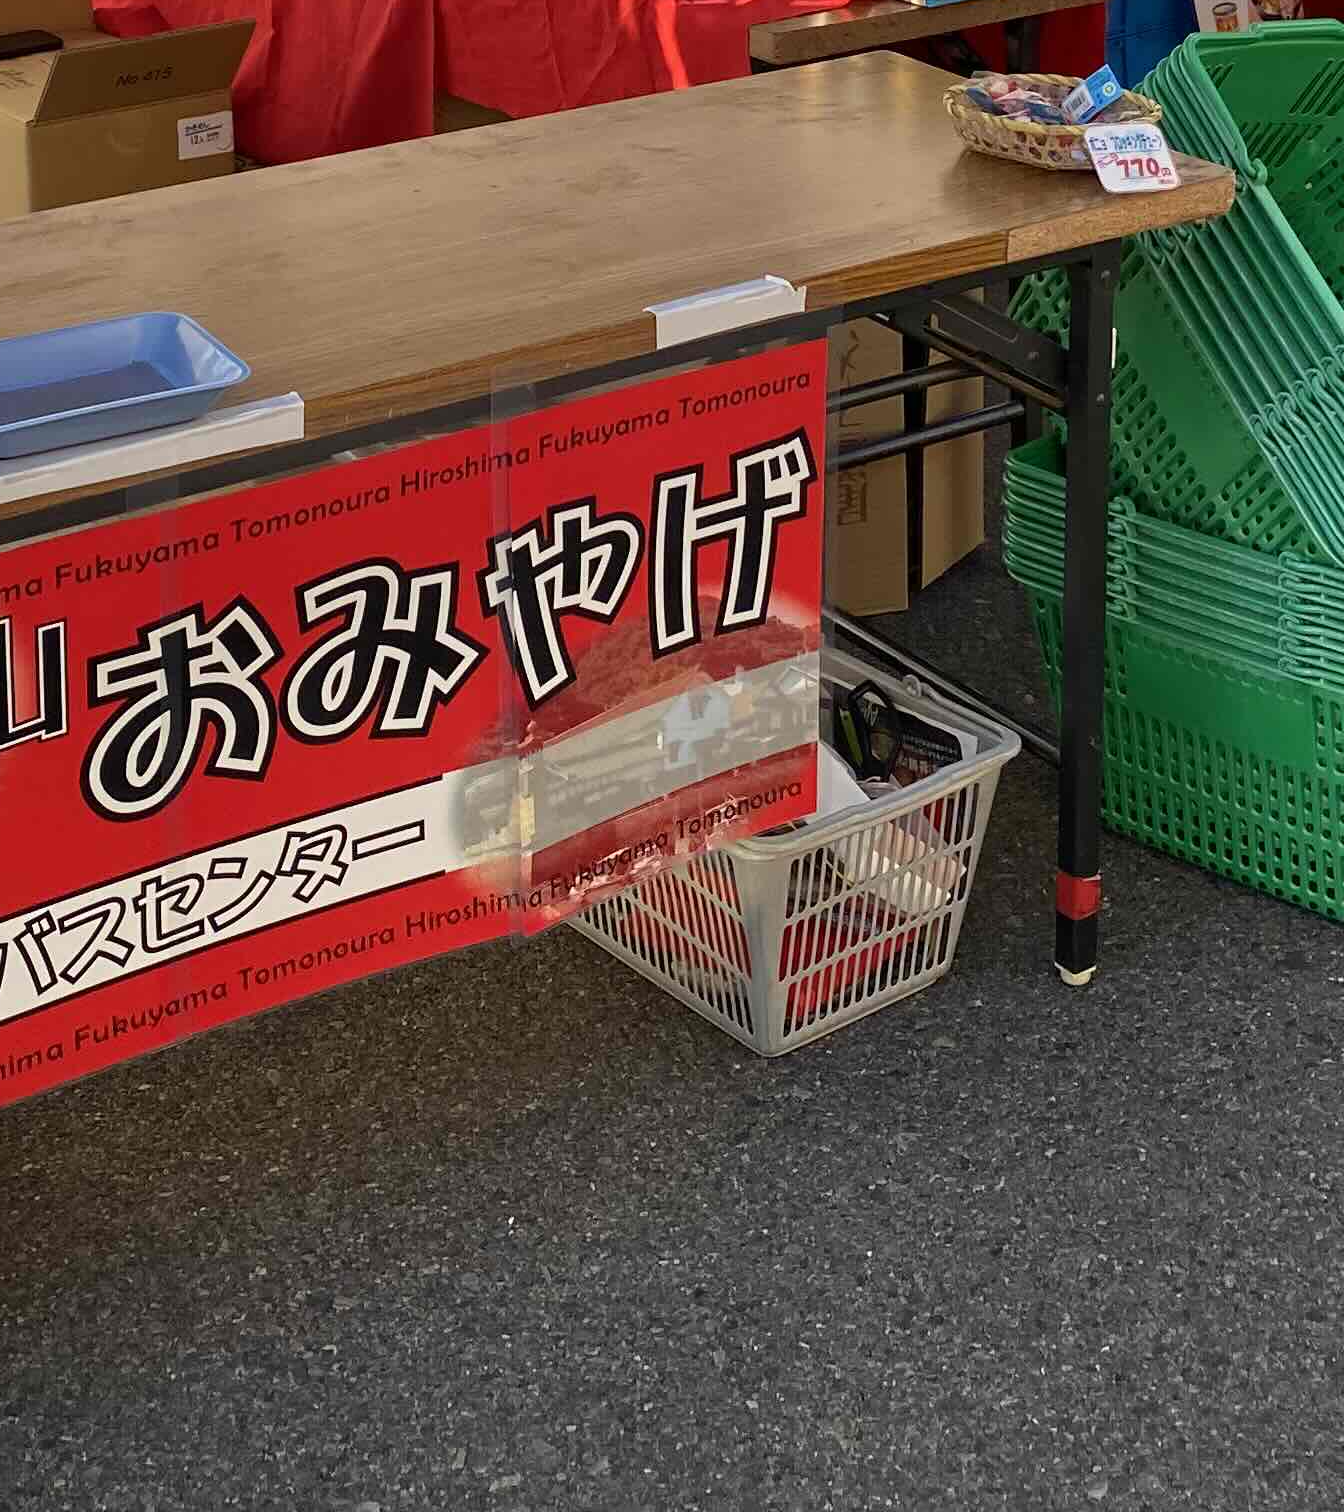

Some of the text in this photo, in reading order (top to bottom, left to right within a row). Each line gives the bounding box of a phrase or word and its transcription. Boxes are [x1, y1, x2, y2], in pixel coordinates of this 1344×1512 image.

[54, 529, 220, 588] Fukuyama
[230, 486, 391, 543] Tomonoura
[400, 447, 531, 498] Hiroshima
[539, 410, 669, 464] Fukuyama
[677, 371, 811, 419] Tomonoura
[79, 425, 818, 823] おみやげ
[72, 980, 228, 1053] Fukuyama
[236, 925, 396, 989] Tomonoura
[405, 885, 542, 937] Hiroshima
[550, 831, 669, 900] Fukuyama
[676, 779, 802, 841] Tomonoura
